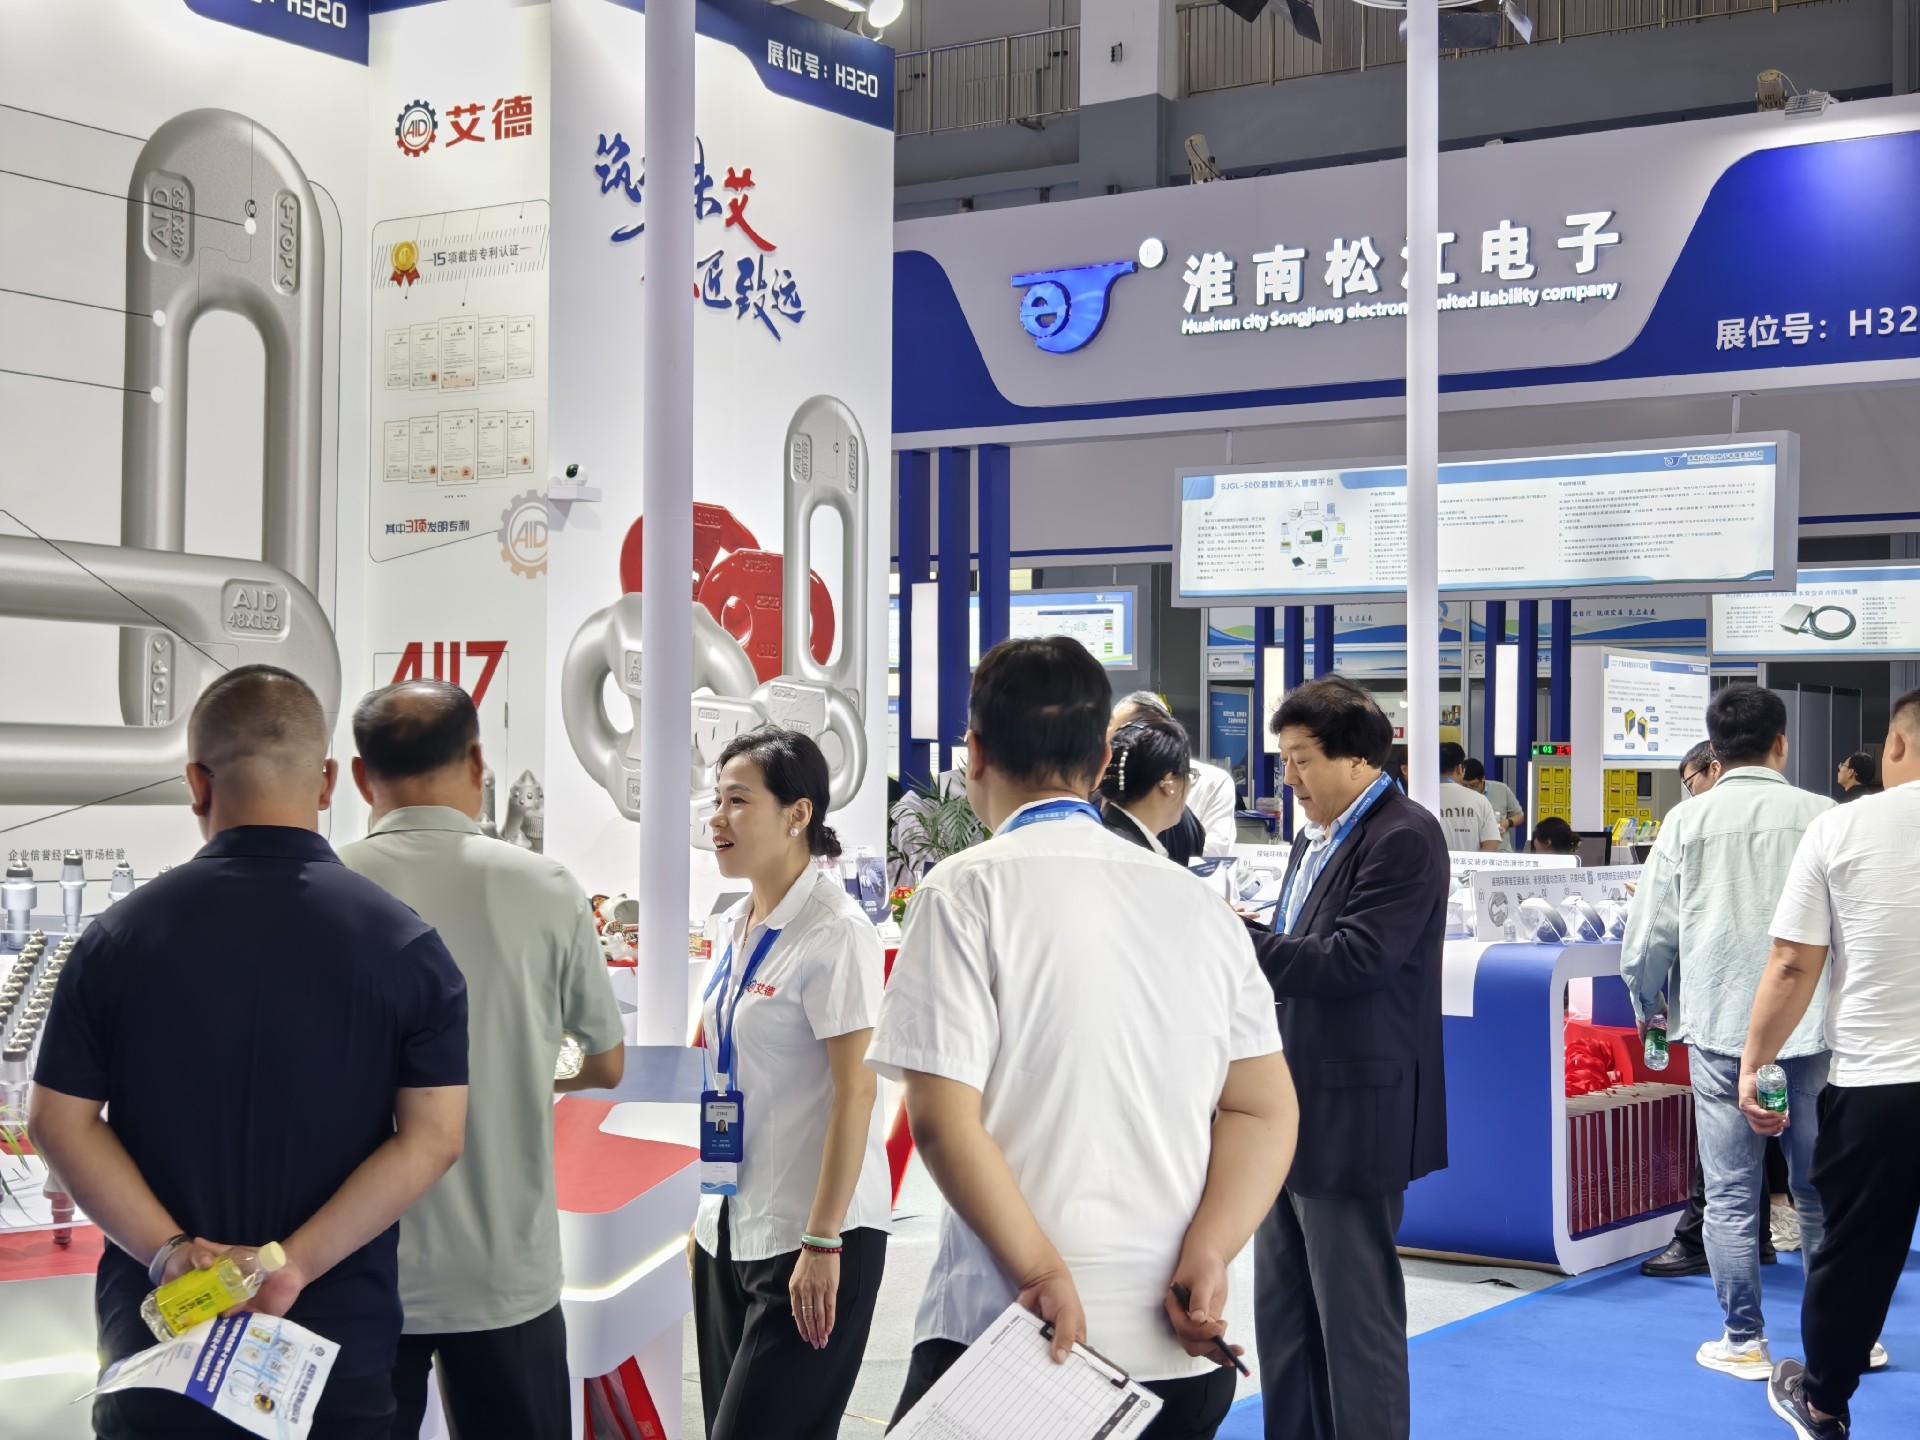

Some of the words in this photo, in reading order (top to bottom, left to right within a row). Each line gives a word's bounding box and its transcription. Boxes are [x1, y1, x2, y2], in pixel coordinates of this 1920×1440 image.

[405, 119, 428, 138] AID
[446, 95, 532, 148] 艾德
[151, 187, 171, 248] AID
[641, 250, 806, 342] 匠致远
[1182, 318, 1241, 335] Huainan
[1243, 313, 1268, 331] city
[1270, 305, 1344, 328] Songjiang
[1347, 302, 1408, 319] electron
[1480, 287, 1539, 307] liability
[1541, 282, 1619, 302] company
[385, 518, 470, 535] 其中3项发明专利
[514, 520, 548, 549] AID
[232, 588, 278, 612] AID
[754, 983, 776, 997] 艾德
